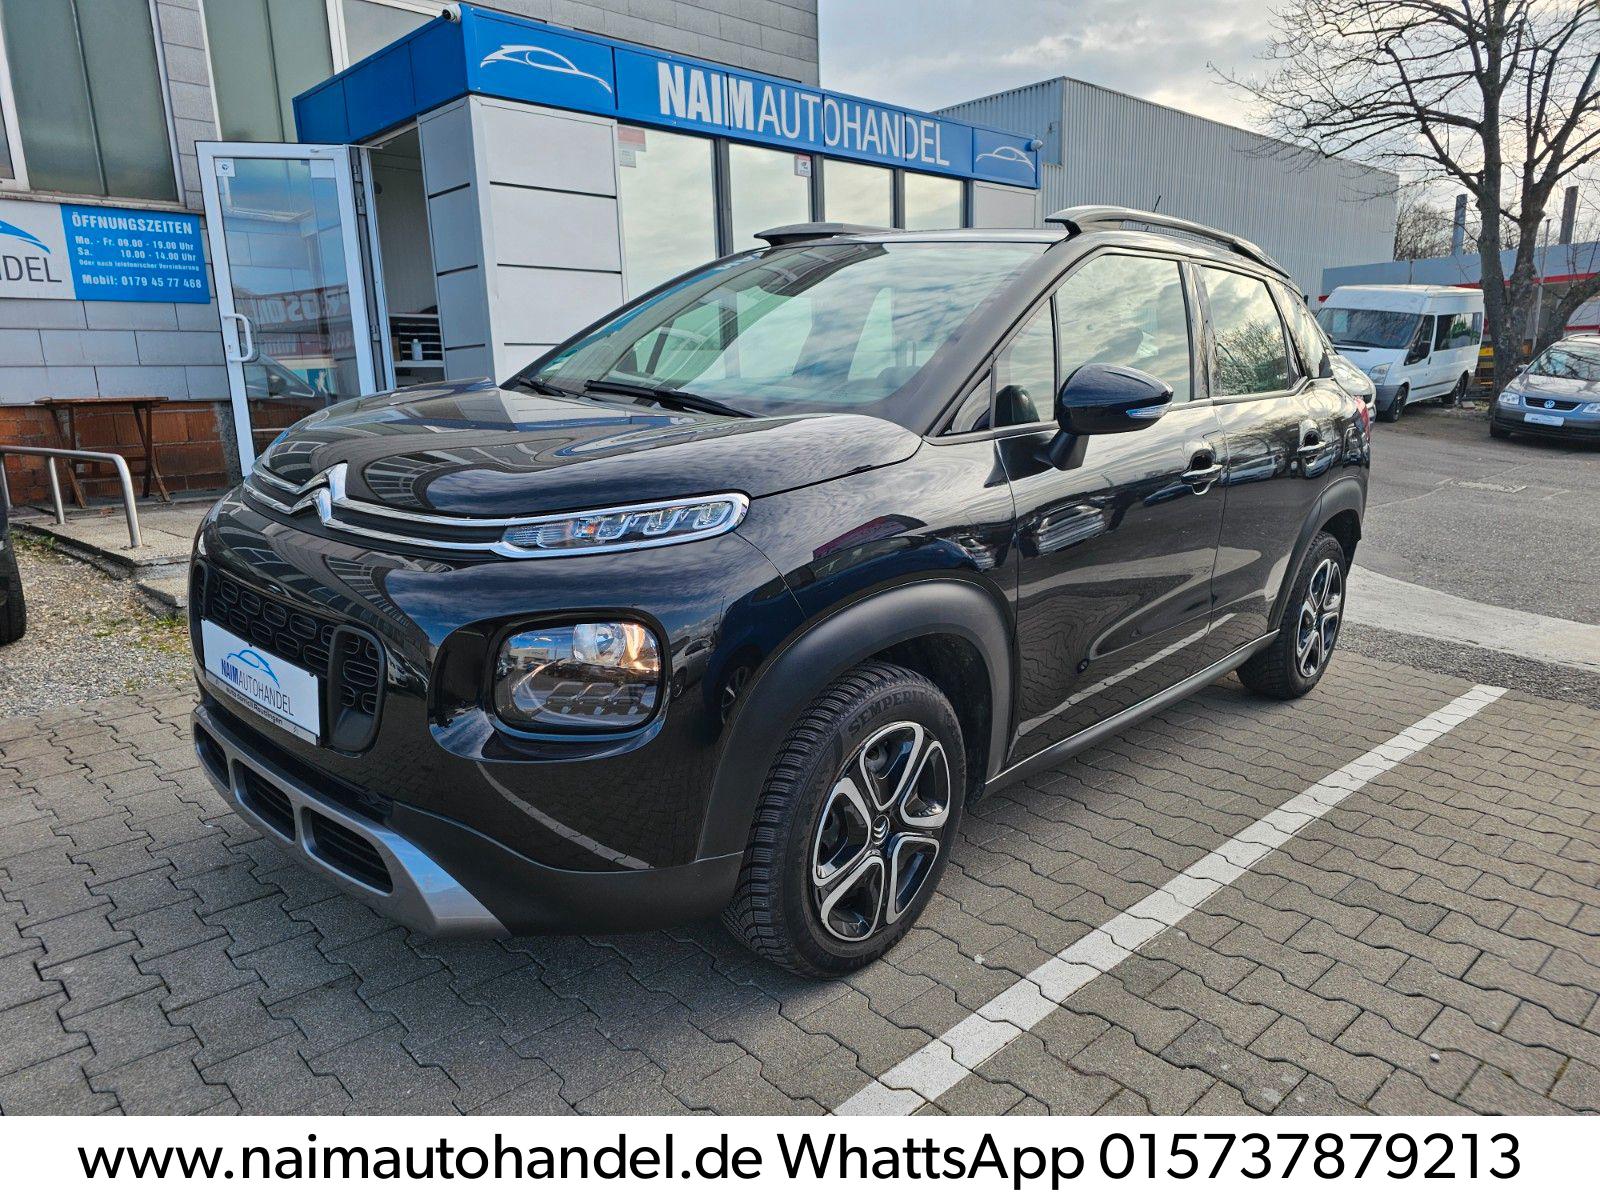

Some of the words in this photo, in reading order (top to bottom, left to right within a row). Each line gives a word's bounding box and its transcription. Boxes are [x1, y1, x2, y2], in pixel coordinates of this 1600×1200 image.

[658, 62, 755, 131] NAIM
[758, 86, 950, 166] AUTOHANDEL
[72, 212, 192, 234] ÖFFNUNGSZEITEN
[75, 236, 93, 245] Mo.
[103, 237, 115, 246] Fr.
[117, 238, 143, 248] 09.00
[153, 240, 177, 250] 19.00
[179, 242, 194, 251] Uhr
[77, 247, 93, 256] Sa.
[120, 249, 146, 259] 10.00
[155, 251, 179, 261] 14.00
[181, 253, 196, 262] Uhr
[0, 255, 62, 283] DEL
[82, 274, 118, 285] Mobil:
[121, 276, 147, 286] 0179
[151, 277, 164, 287] 45
[167, 278, 179, 287] 77
[183, 279, 202, 289] 468
[239, 671, 294, 716] AUTOHANDEL
